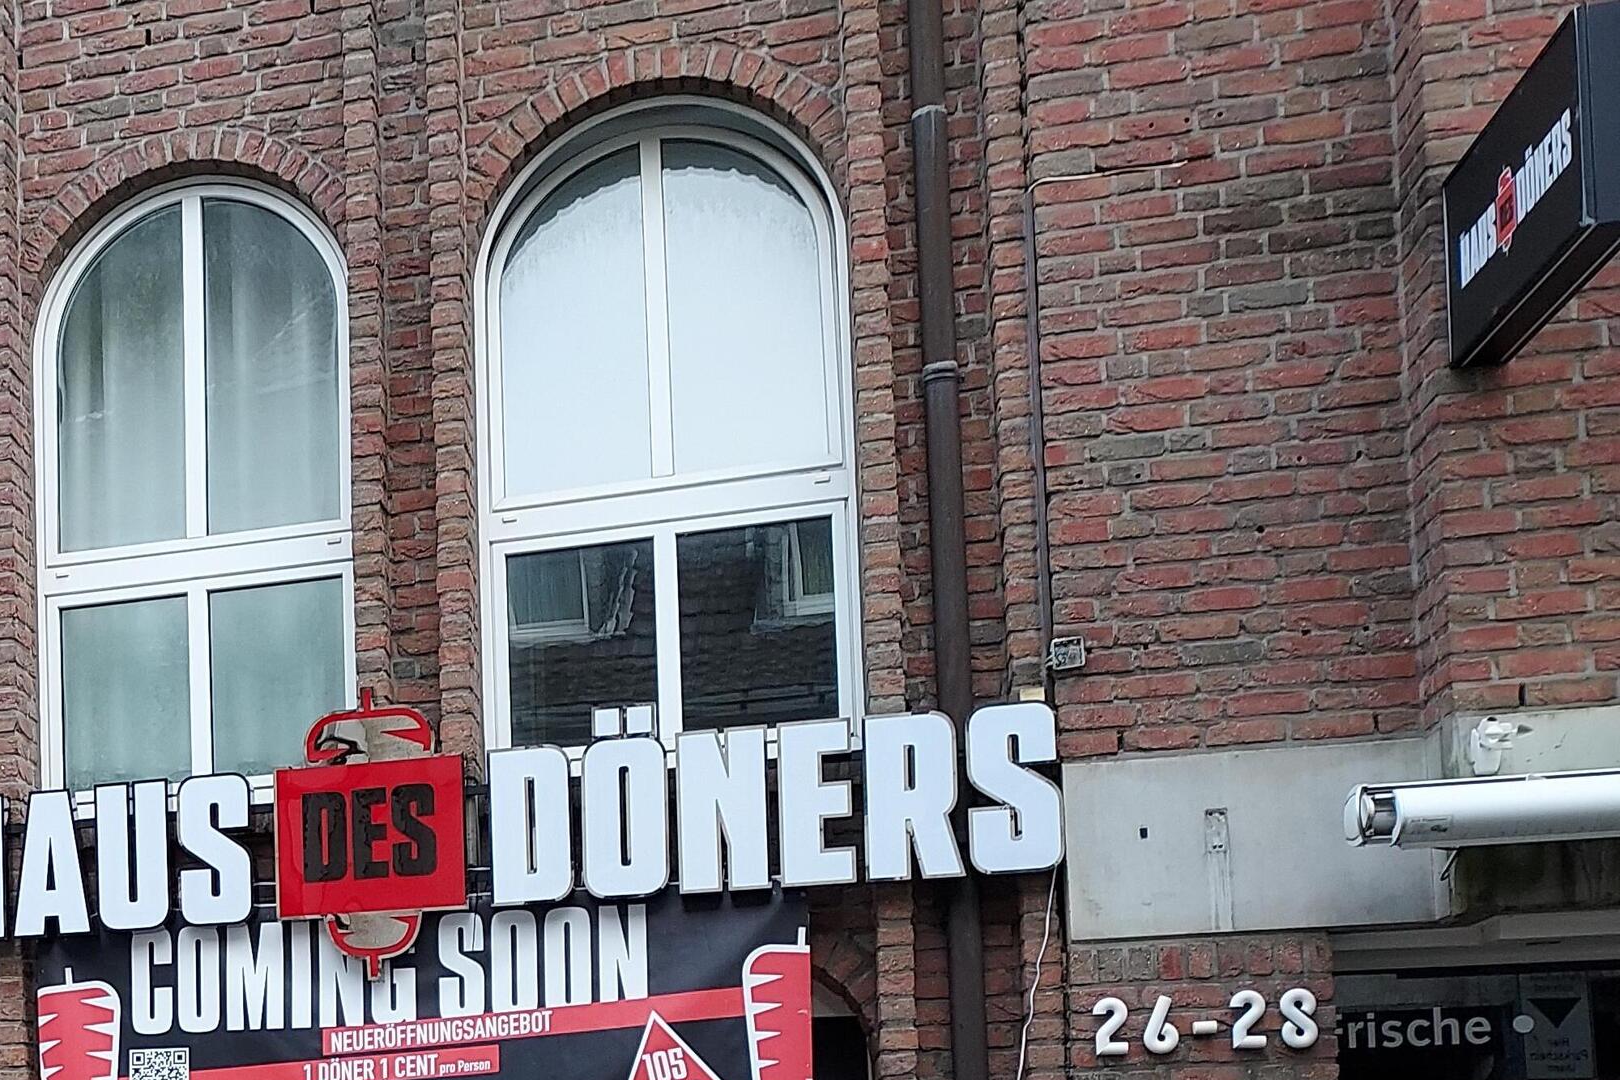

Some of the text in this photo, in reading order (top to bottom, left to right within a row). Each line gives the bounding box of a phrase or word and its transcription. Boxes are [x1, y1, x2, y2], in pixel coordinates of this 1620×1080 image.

[301, 783, 438, 883] DES
[488, 701, 1066, 905] DÖNERS
[438, 904, 649, 1019] SOON
[331, 1011, 553, 1053] NEUERÖFFNUNGSANGEBOT
[1092, 987, 1319, 1056] 26-28
[380, 1057, 388, 1079] 1
[394, 1054, 439, 1077] CENT
[439, 1064, 456, 1076] pro
[457, 1059, 491, 1072] Person
